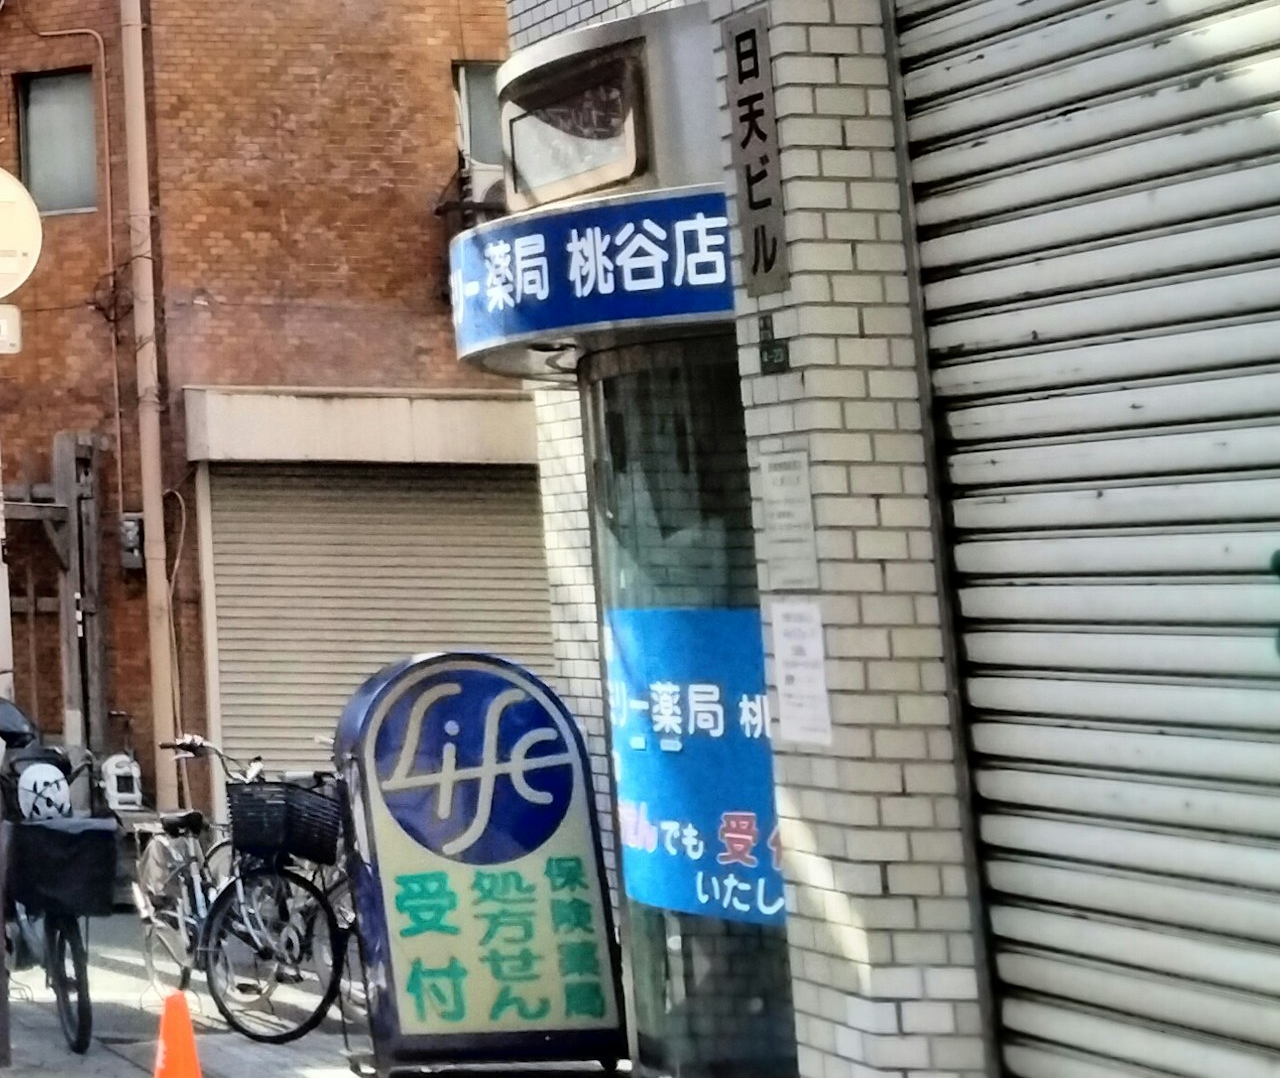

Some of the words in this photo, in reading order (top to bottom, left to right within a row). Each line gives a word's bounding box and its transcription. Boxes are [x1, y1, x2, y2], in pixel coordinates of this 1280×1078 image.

[734, 28, 778, 276] 日天ビル
[566, 212, 730, 299] 桃谷店
[381, 682, 560, 856] Life
[395, 870, 469, 1022] 受付
[471, 869, 552, 1022] 処方せん
